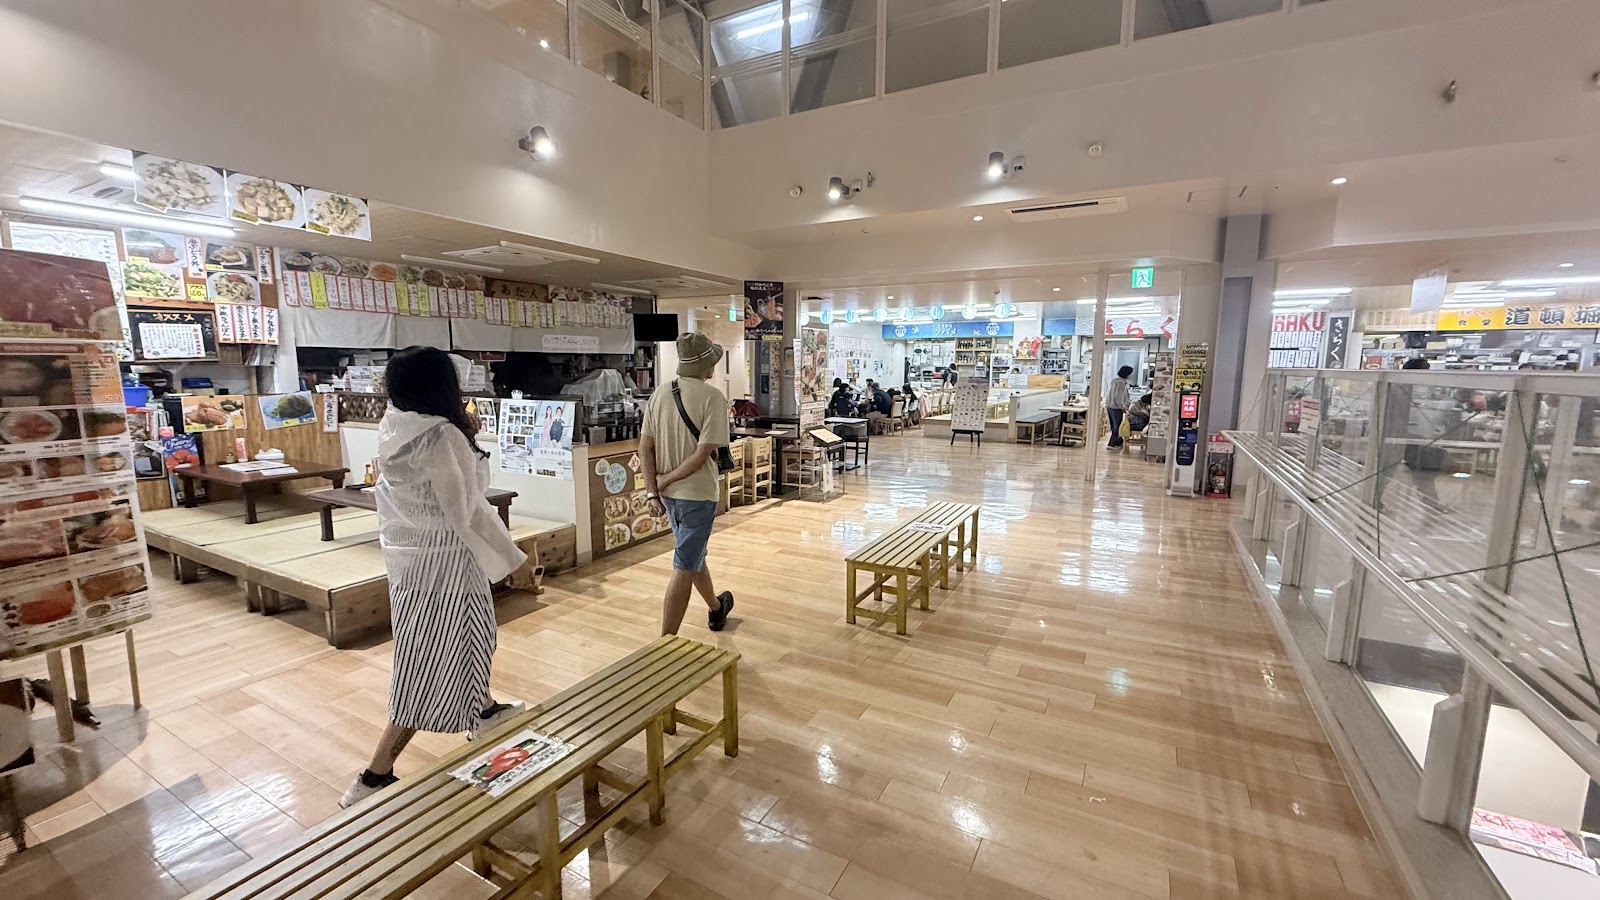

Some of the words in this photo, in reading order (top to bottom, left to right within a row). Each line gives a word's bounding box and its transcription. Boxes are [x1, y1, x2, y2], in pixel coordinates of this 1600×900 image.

[502, 285, 538, 298] あだん
[1505, 305, 1600, 326] 道頓堀
[933, 328, 957, 336] ツバメ
